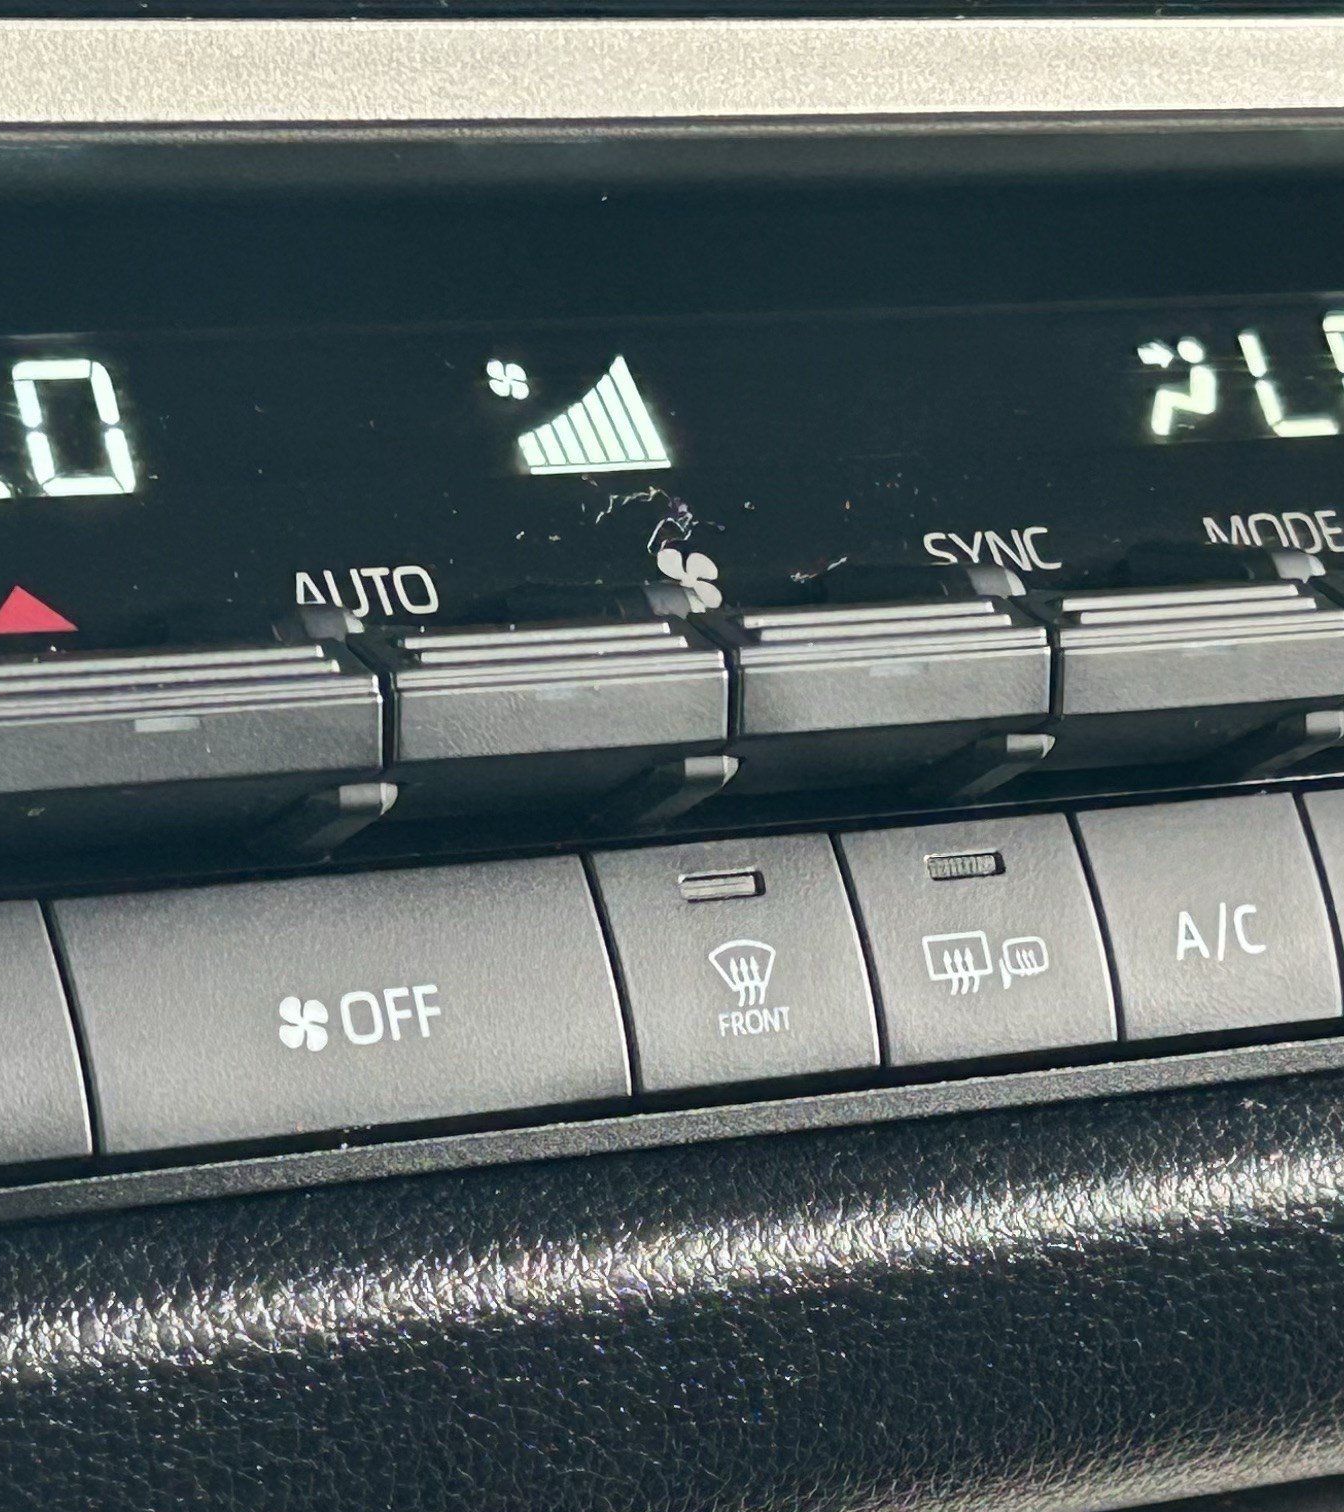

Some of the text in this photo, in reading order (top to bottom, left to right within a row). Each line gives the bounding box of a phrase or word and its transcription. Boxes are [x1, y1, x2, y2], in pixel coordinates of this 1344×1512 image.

[923, 526, 1062, 571] SYNC
[296, 565, 439, 618] AUTO
[1176, 902, 1266, 961] A/C
[340, 984, 441, 1045] OFF
[718, 1006, 790, 1037] FRONT
